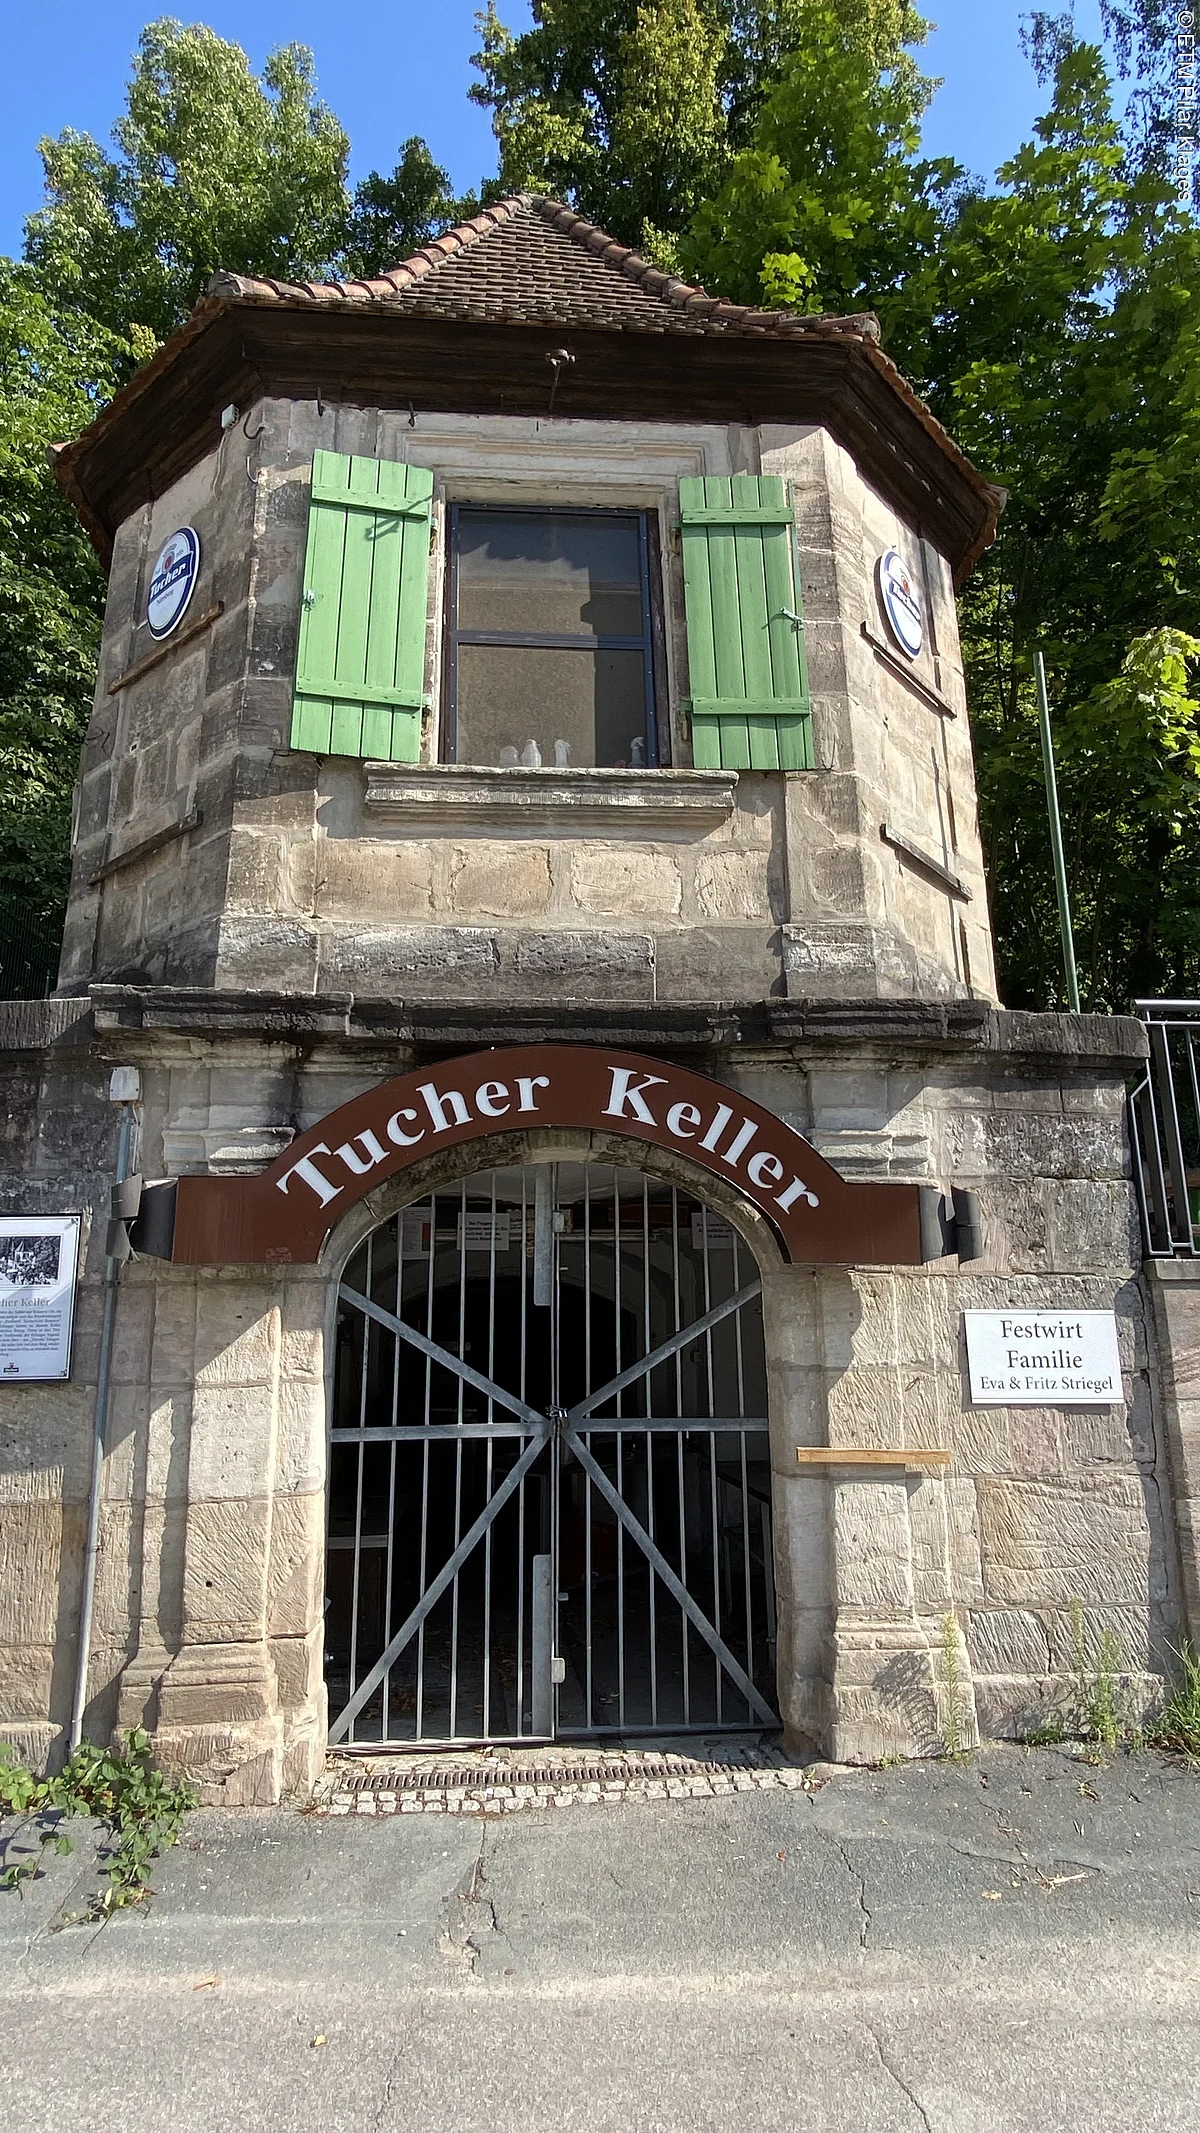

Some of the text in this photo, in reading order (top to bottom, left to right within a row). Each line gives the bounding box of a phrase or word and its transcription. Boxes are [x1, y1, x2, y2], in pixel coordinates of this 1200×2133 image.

[149, 562, 187, 600] Tucher
[275, 1065, 821, 1215] Tucher Keller
[1000, 1320, 1084, 1339] Festwirt
[1006, 1349, 1083, 1369] Familie
[980, 1375, 1114, 1394] Eva & Fritz Striegel
